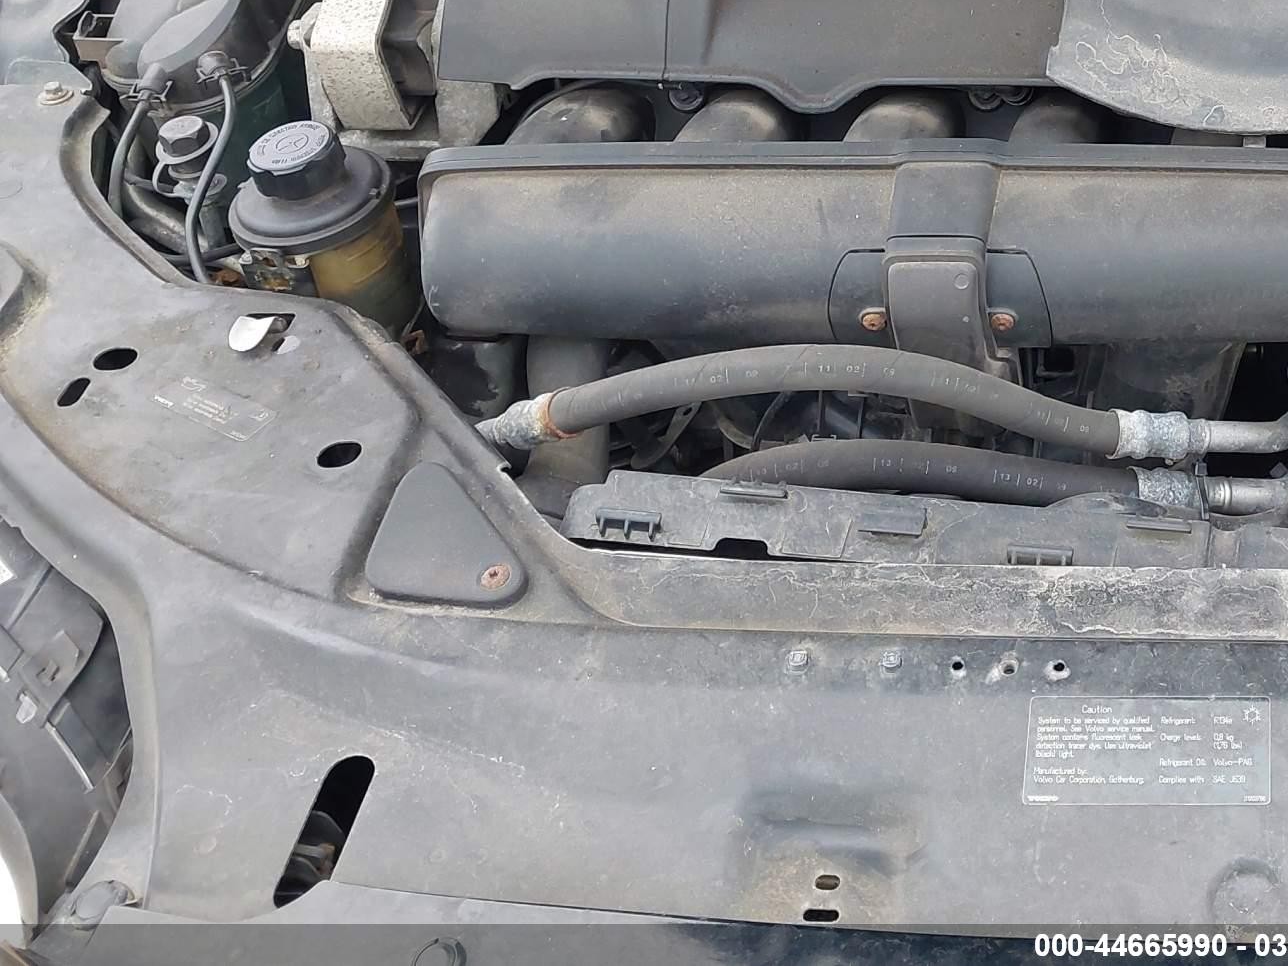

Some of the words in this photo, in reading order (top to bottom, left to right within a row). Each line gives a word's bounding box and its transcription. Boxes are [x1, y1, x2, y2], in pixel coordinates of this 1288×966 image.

[1026, 477, 1038, 486] 02
[1081, 705, 1112, 714] Caution
[1038, 717, 1060, 725] System
[1112, 717, 1120, 725] by
[1213, 775, 1225, 783] SAE
